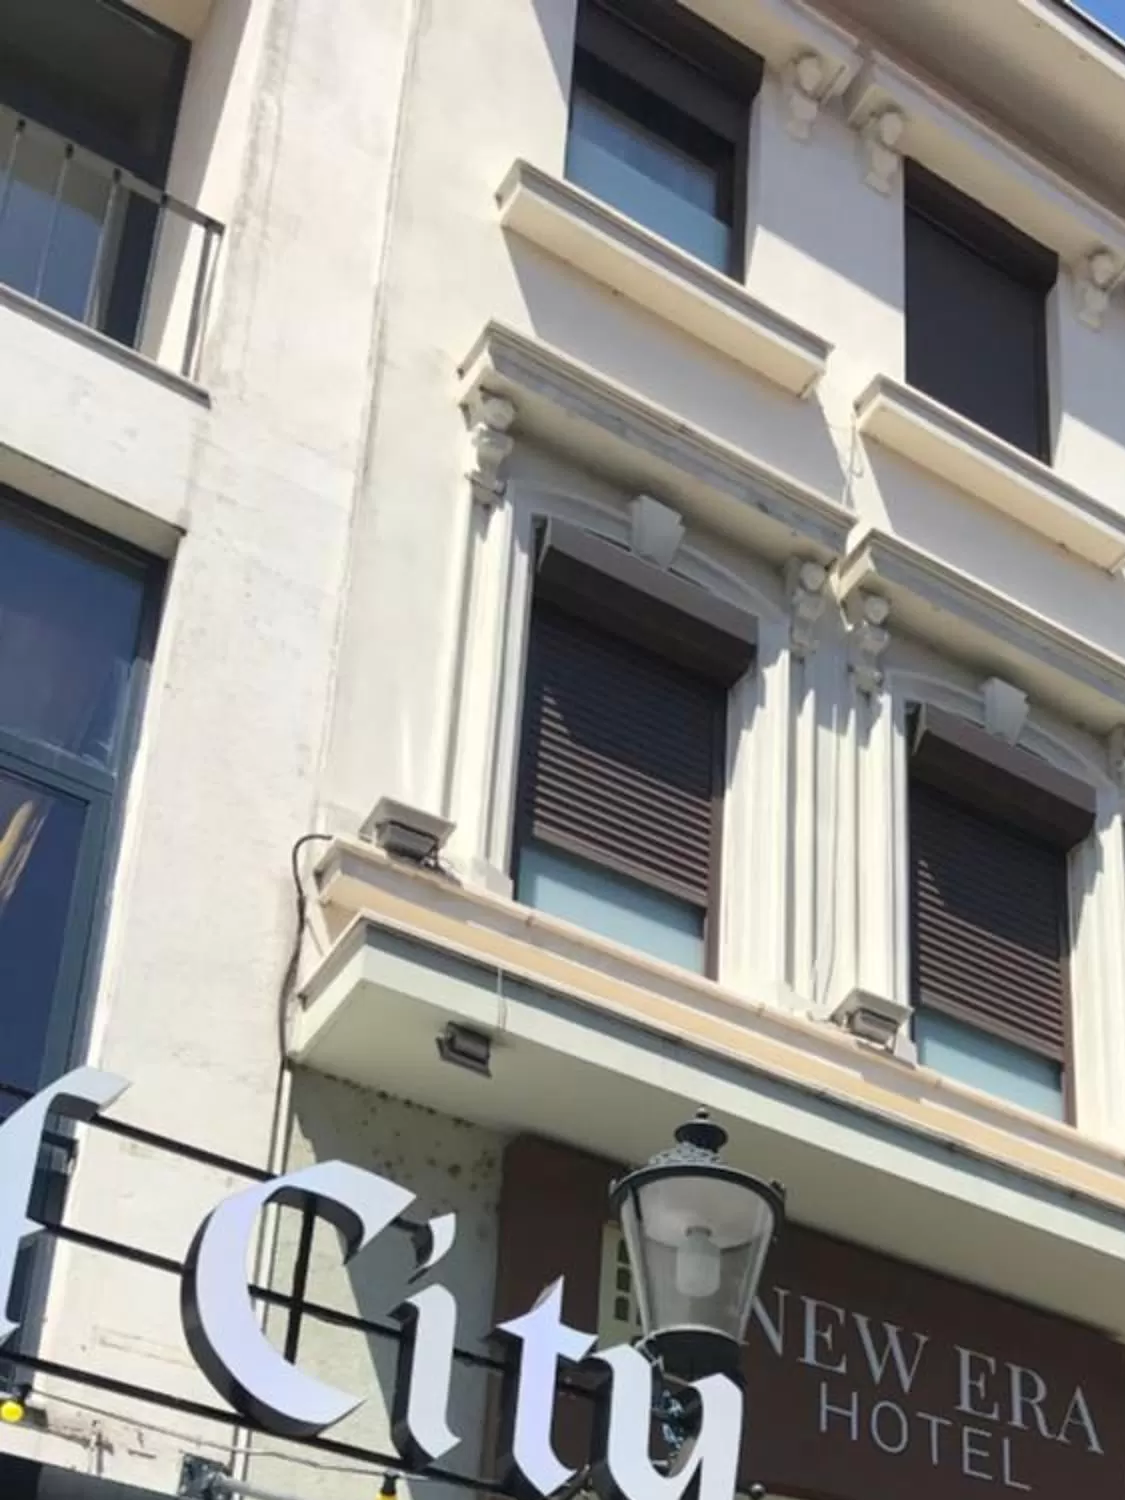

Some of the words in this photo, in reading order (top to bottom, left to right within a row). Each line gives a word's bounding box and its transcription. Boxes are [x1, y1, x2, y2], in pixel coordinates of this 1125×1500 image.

[738, 1285, 929, 1395] NEW
[953, 1343, 1105, 1456] ERA
[818, 1380, 1033, 1492] HOTEL
